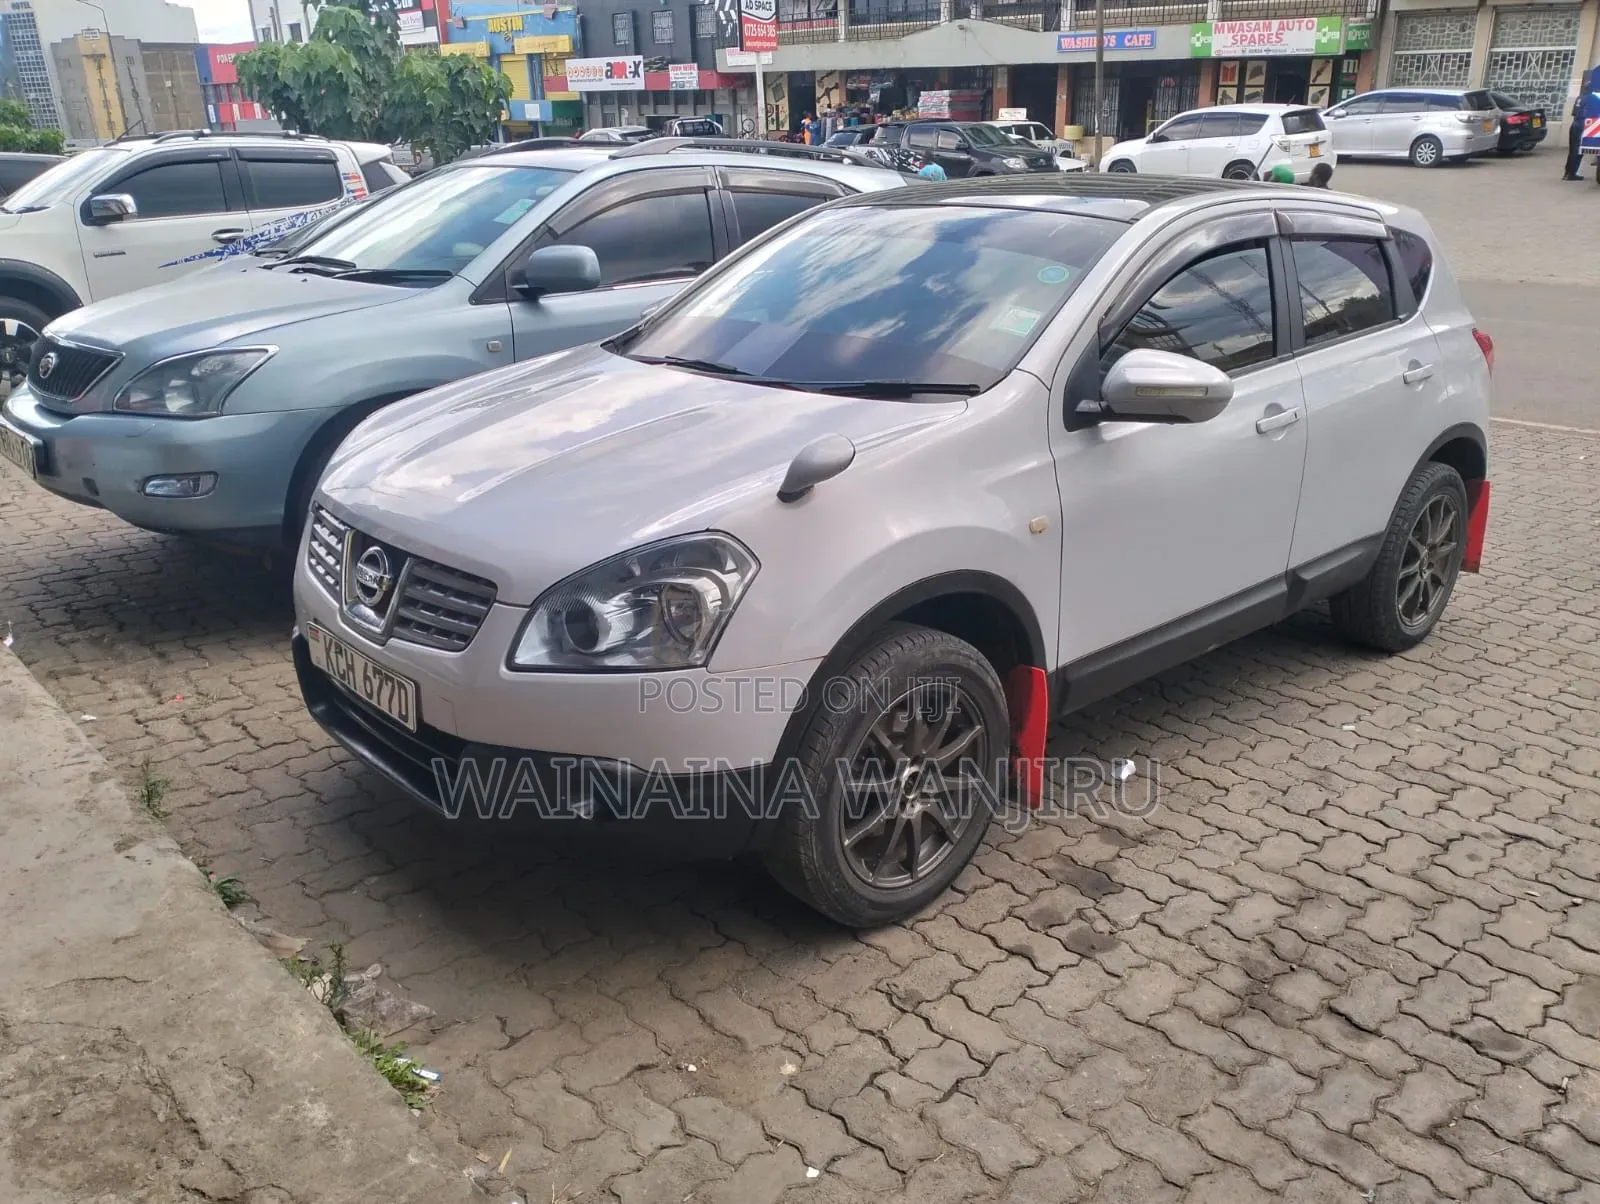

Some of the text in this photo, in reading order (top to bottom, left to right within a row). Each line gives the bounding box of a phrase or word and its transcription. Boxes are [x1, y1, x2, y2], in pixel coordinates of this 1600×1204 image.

[745, 0, 773, 11] AD SPACE
[1214, 19, 1316, 34] MWASAM AUTO
[1124, 33, 1152, 47] CAFE
[1231, 32, 1284, 46] SPARES
[323, 634, 409, 723] KCH 677D
